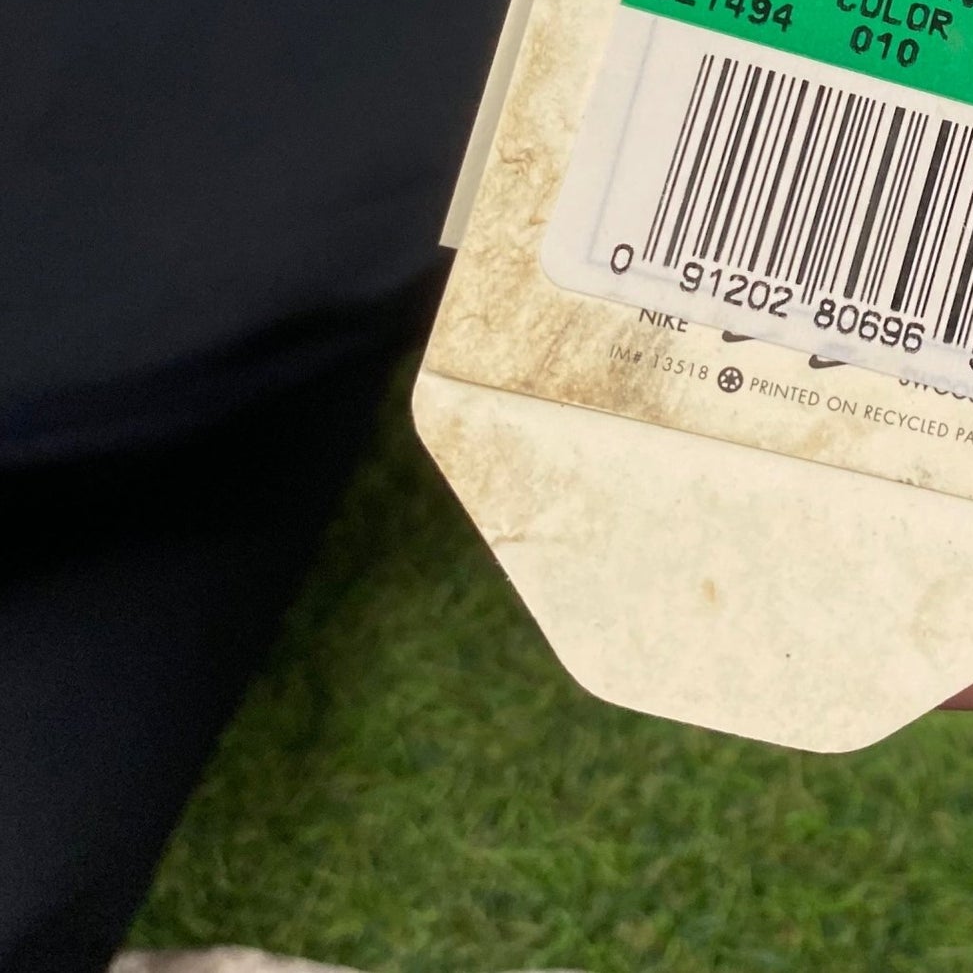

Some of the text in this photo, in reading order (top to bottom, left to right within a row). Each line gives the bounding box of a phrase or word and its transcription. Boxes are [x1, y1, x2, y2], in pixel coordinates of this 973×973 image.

[849, 25, 919, 67] 010
[610, 243, 634, 274] 0
[679, 262, 793, 318] 91202
[813, 298, 926, 353] 80696
[639, 307, 689, 333] NIKE
[609, 344, 642, 364] IM#
[652, 353, 709, 381] 13518
[748, 377, 821, 407] PRINTED
[827, 396, 858, 415] ON
[863, 403, 949, 438] RECYCLED
